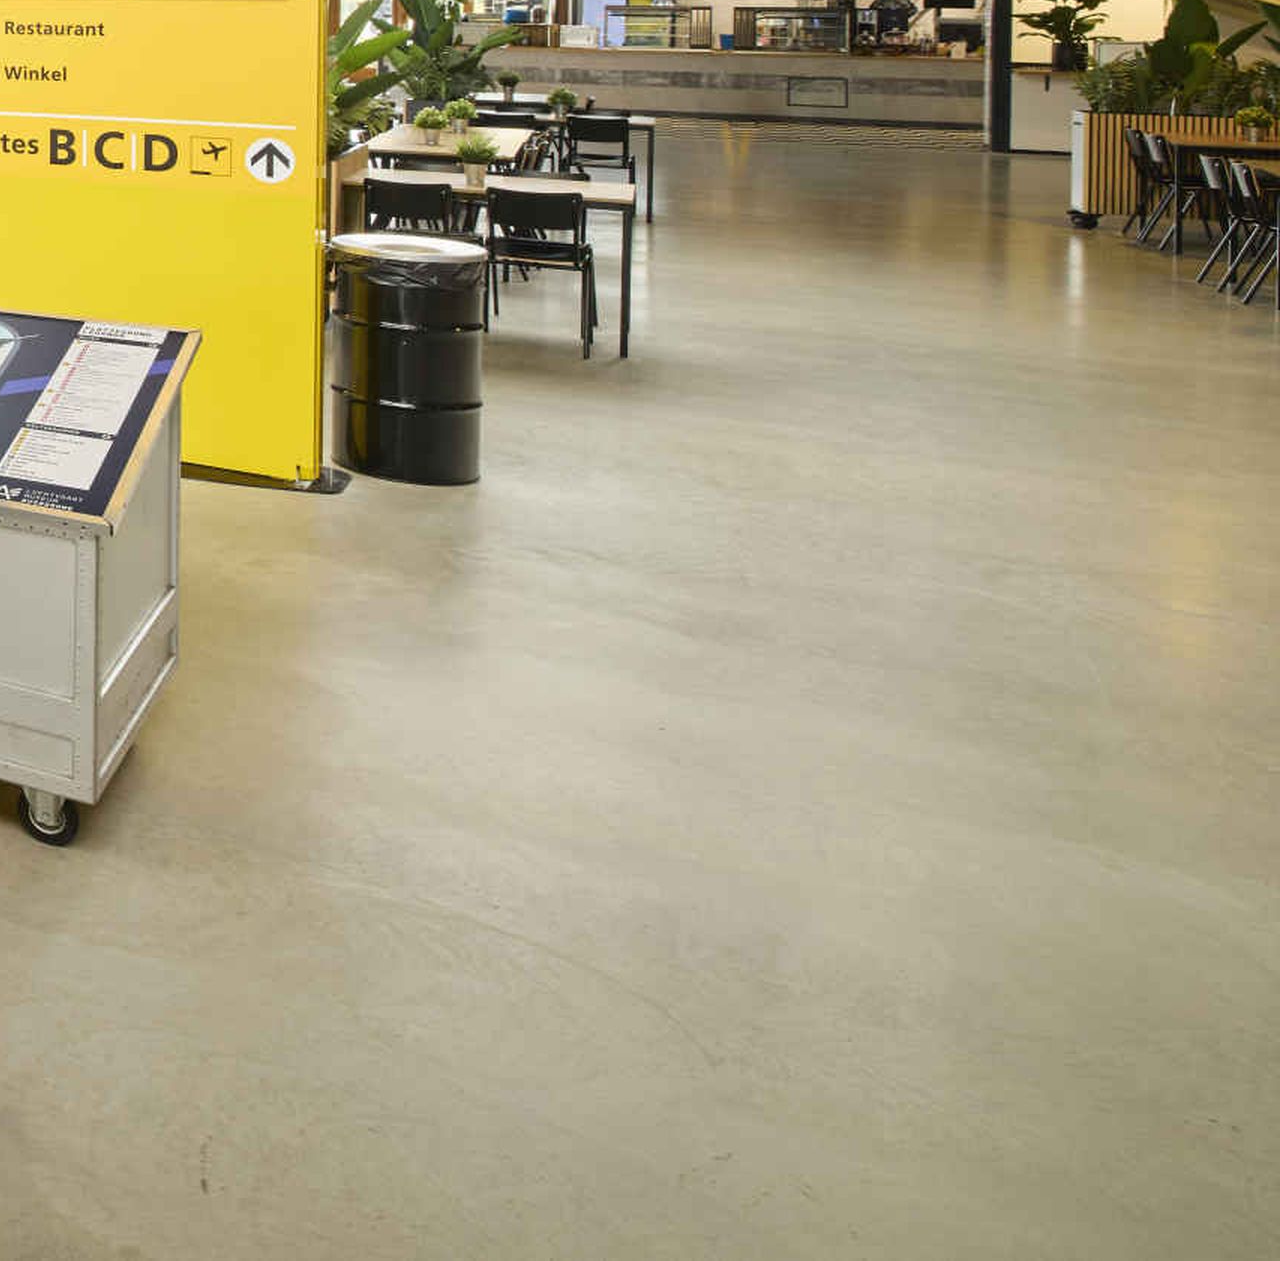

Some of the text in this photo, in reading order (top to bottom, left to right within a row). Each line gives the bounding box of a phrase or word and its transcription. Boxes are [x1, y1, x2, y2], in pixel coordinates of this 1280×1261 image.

[4, 20, 105, 37] Restaurant
[4, 65, 67, 82] Winkel
[49, 128, 77, 166] B
[94, 131, 125, 170] C
[144, 133, 179, 172] D
